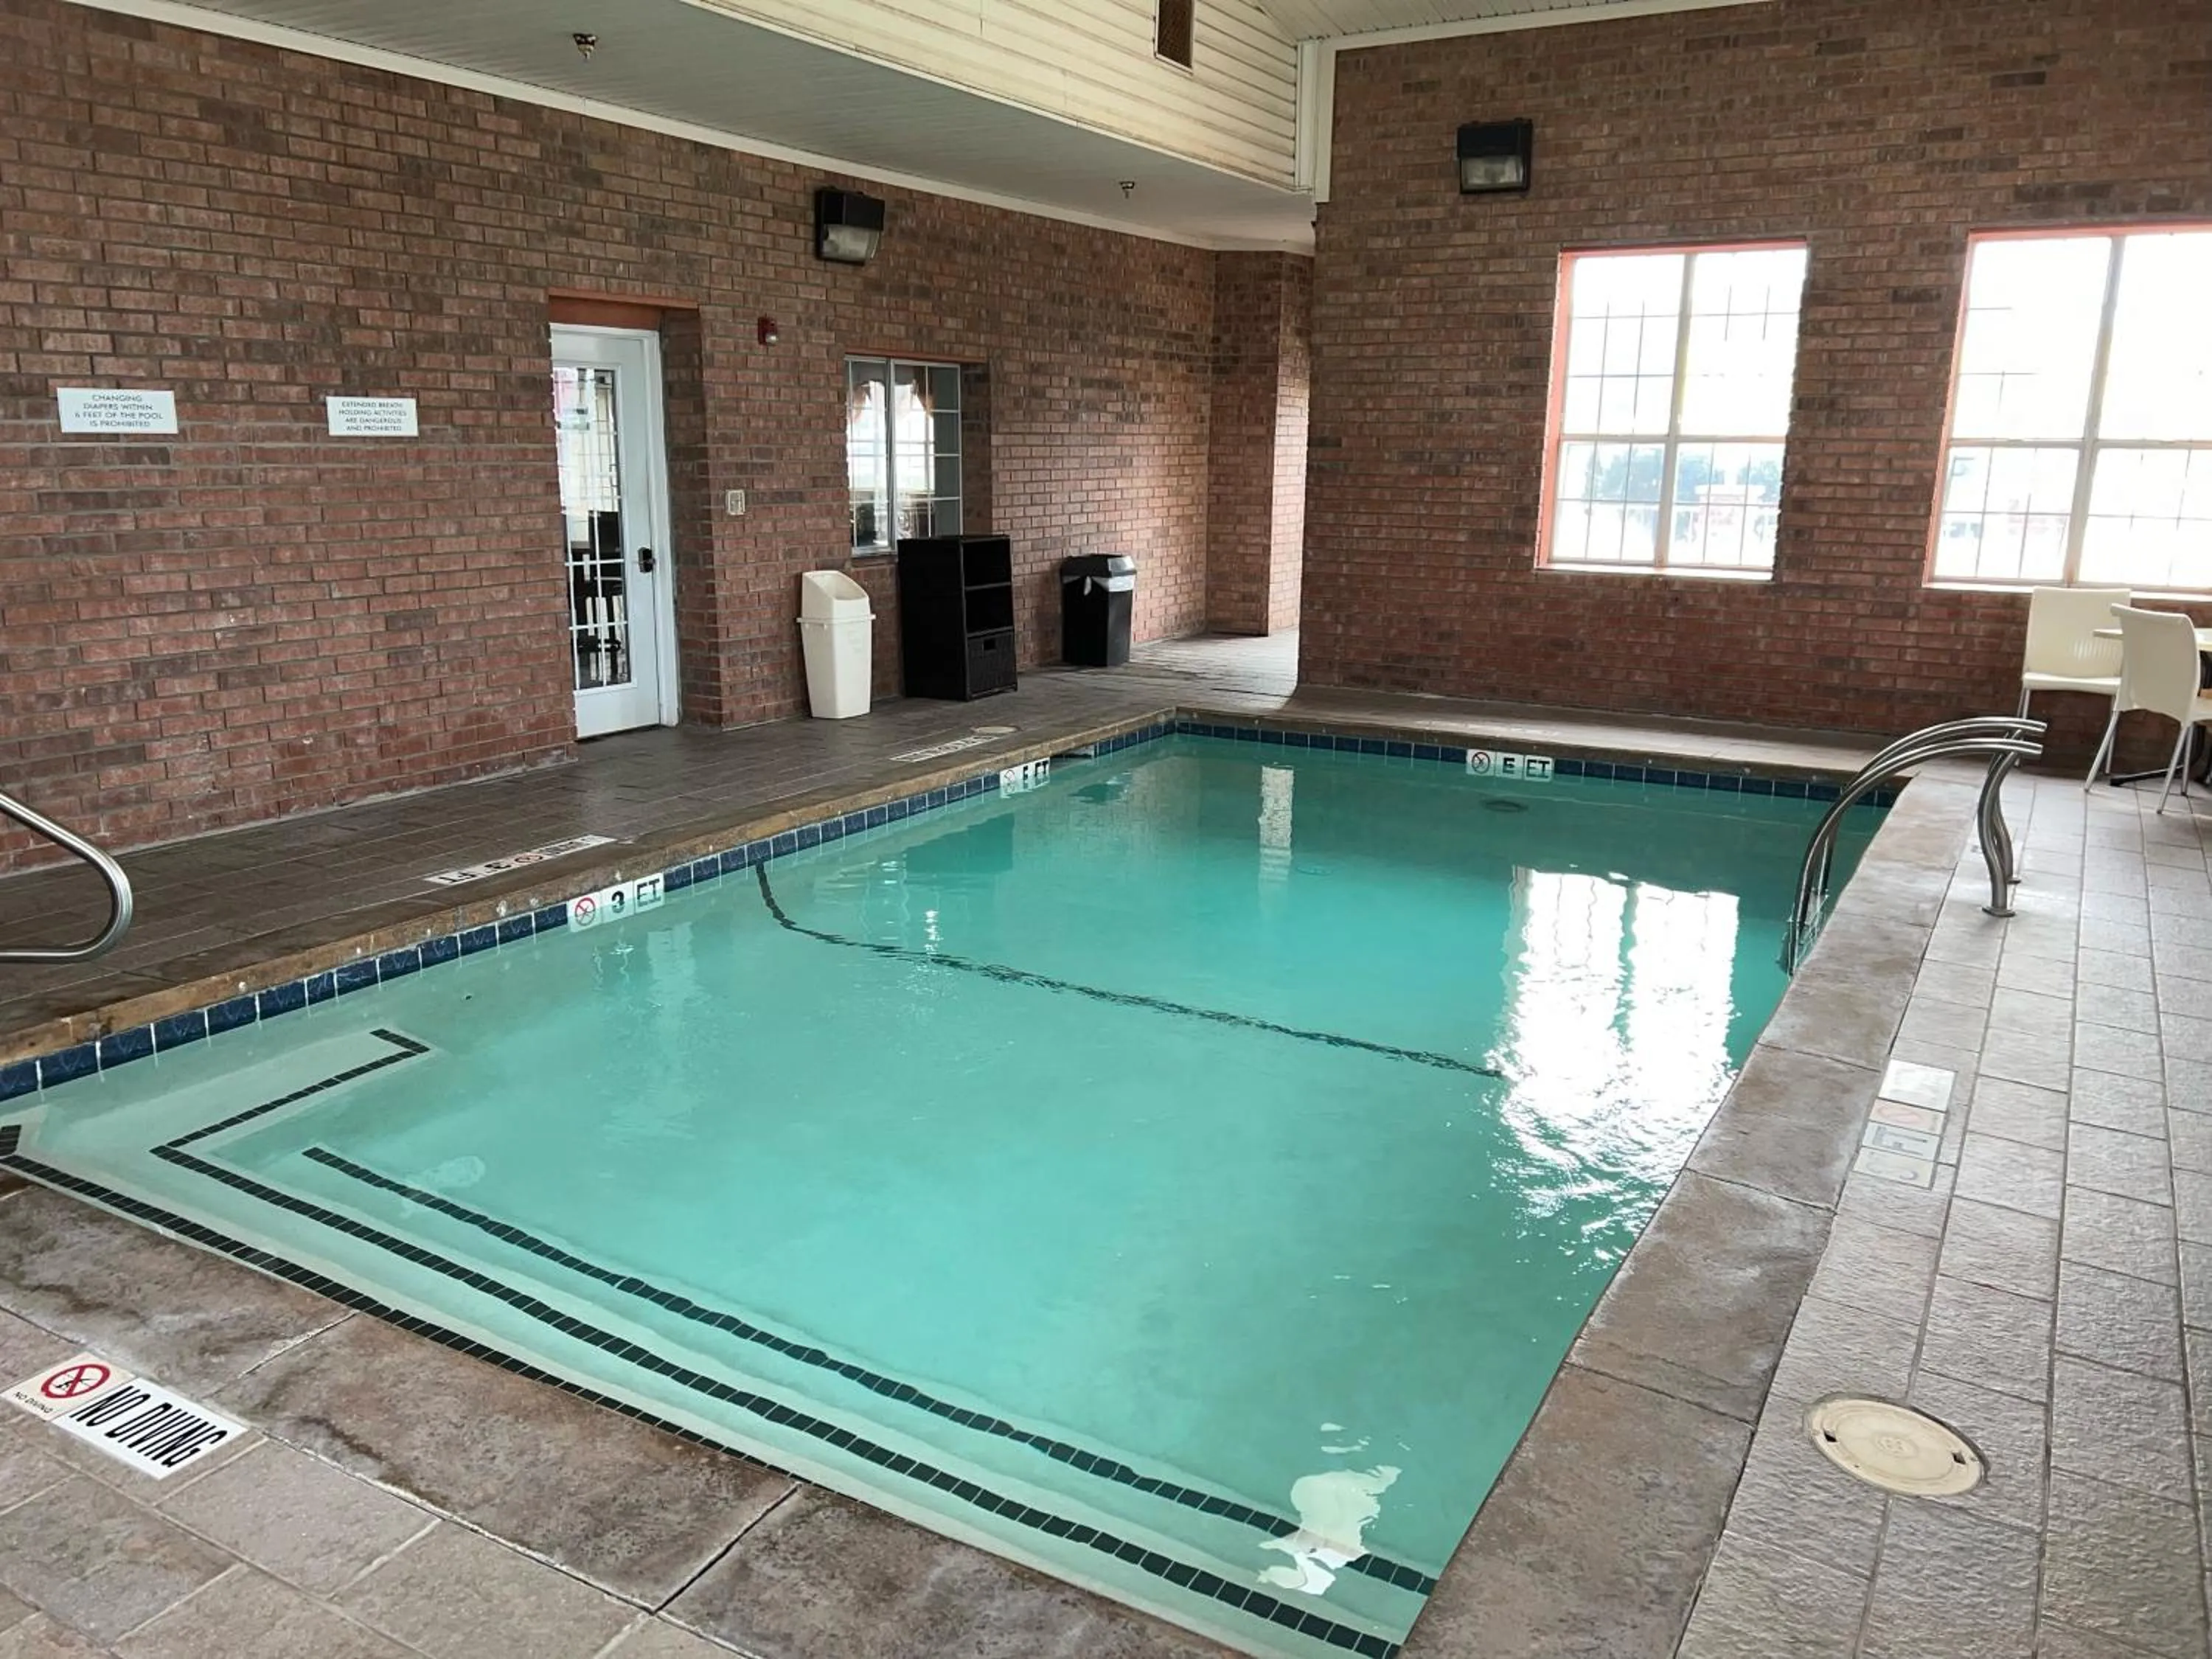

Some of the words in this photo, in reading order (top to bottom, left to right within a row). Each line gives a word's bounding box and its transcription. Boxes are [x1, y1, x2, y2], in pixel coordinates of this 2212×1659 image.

[83, 403, 118, 411] DIAPERS
[14, 1391, 28, 1400] NO
[69, 1385, 151, 1427] NO
[104, 1402, 228, 1467] DIVING
